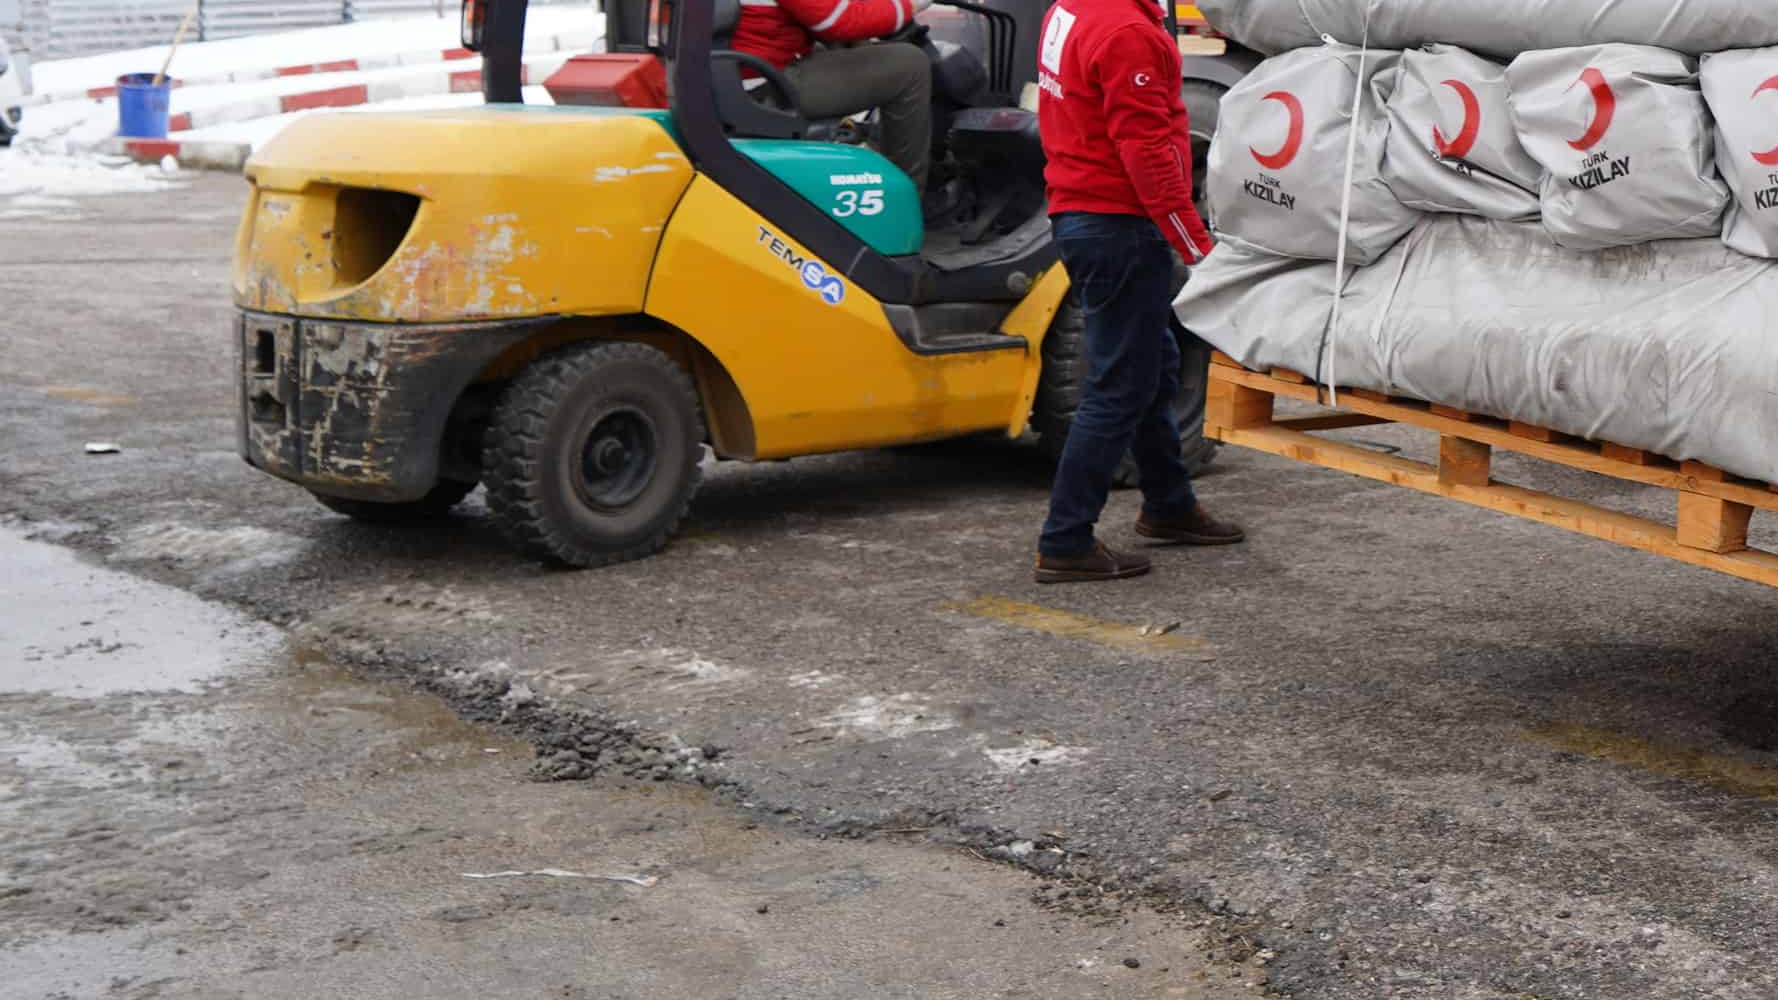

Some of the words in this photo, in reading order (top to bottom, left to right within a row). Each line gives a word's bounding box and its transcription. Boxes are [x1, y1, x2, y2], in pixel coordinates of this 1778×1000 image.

[1568, 155, 1630, 190] KIZILAY
[831, 189, 885, 217] 35
[1244, 178, 1296, 211] KIZILAY
[757, 225, 845, 304] TEMSA
